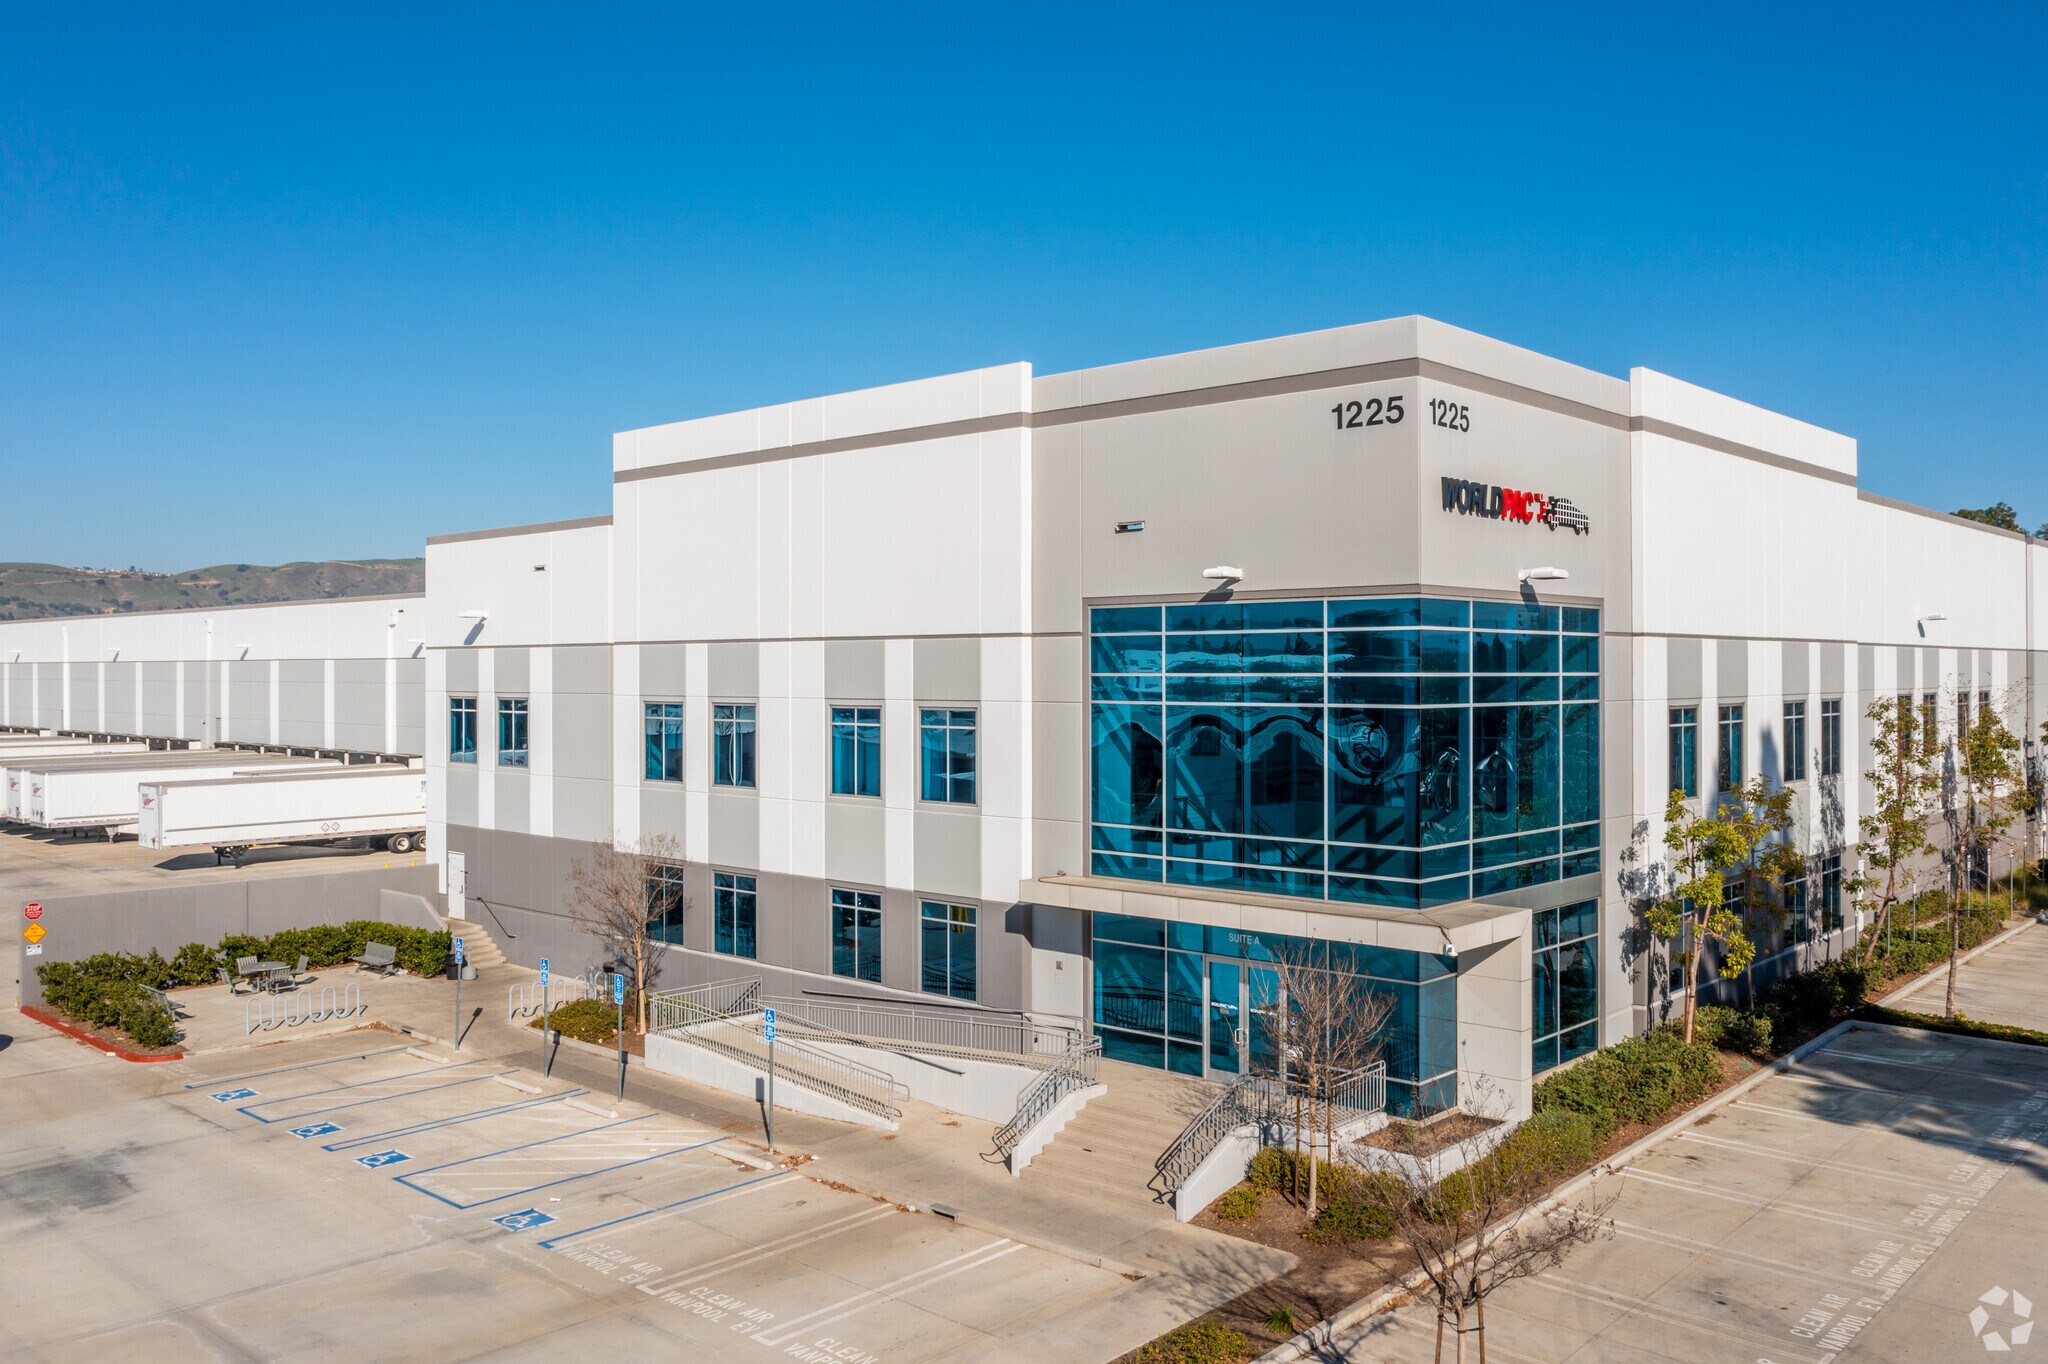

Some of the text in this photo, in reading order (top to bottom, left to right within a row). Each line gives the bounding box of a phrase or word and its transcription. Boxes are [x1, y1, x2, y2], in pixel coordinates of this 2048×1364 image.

[1331, 396, 1405, 430] 1225
[1429, 398, 1470, 433] 1225
[1441, 476, 1534, 525] WORLDPAC
[1228, 932, 1260, 946] SUITE A
[558, 1246, 648, 1285] VANPOOL EV
[586, 1243, 662, 1275] CLEAN AIR
[1851, 1240, 1905, 1278] CLEAN AIR
[660, 1290, 761, 1334] VANPOOL EV
[689, 1286, 775, 1323] CLEAN AIR
[1789, 1293, 1851, 1338] CLEAN AIR
[1816, 1296, 1884, 1351] VANPOOL EV
[814, 1337, 880, 1364] CLEAN
